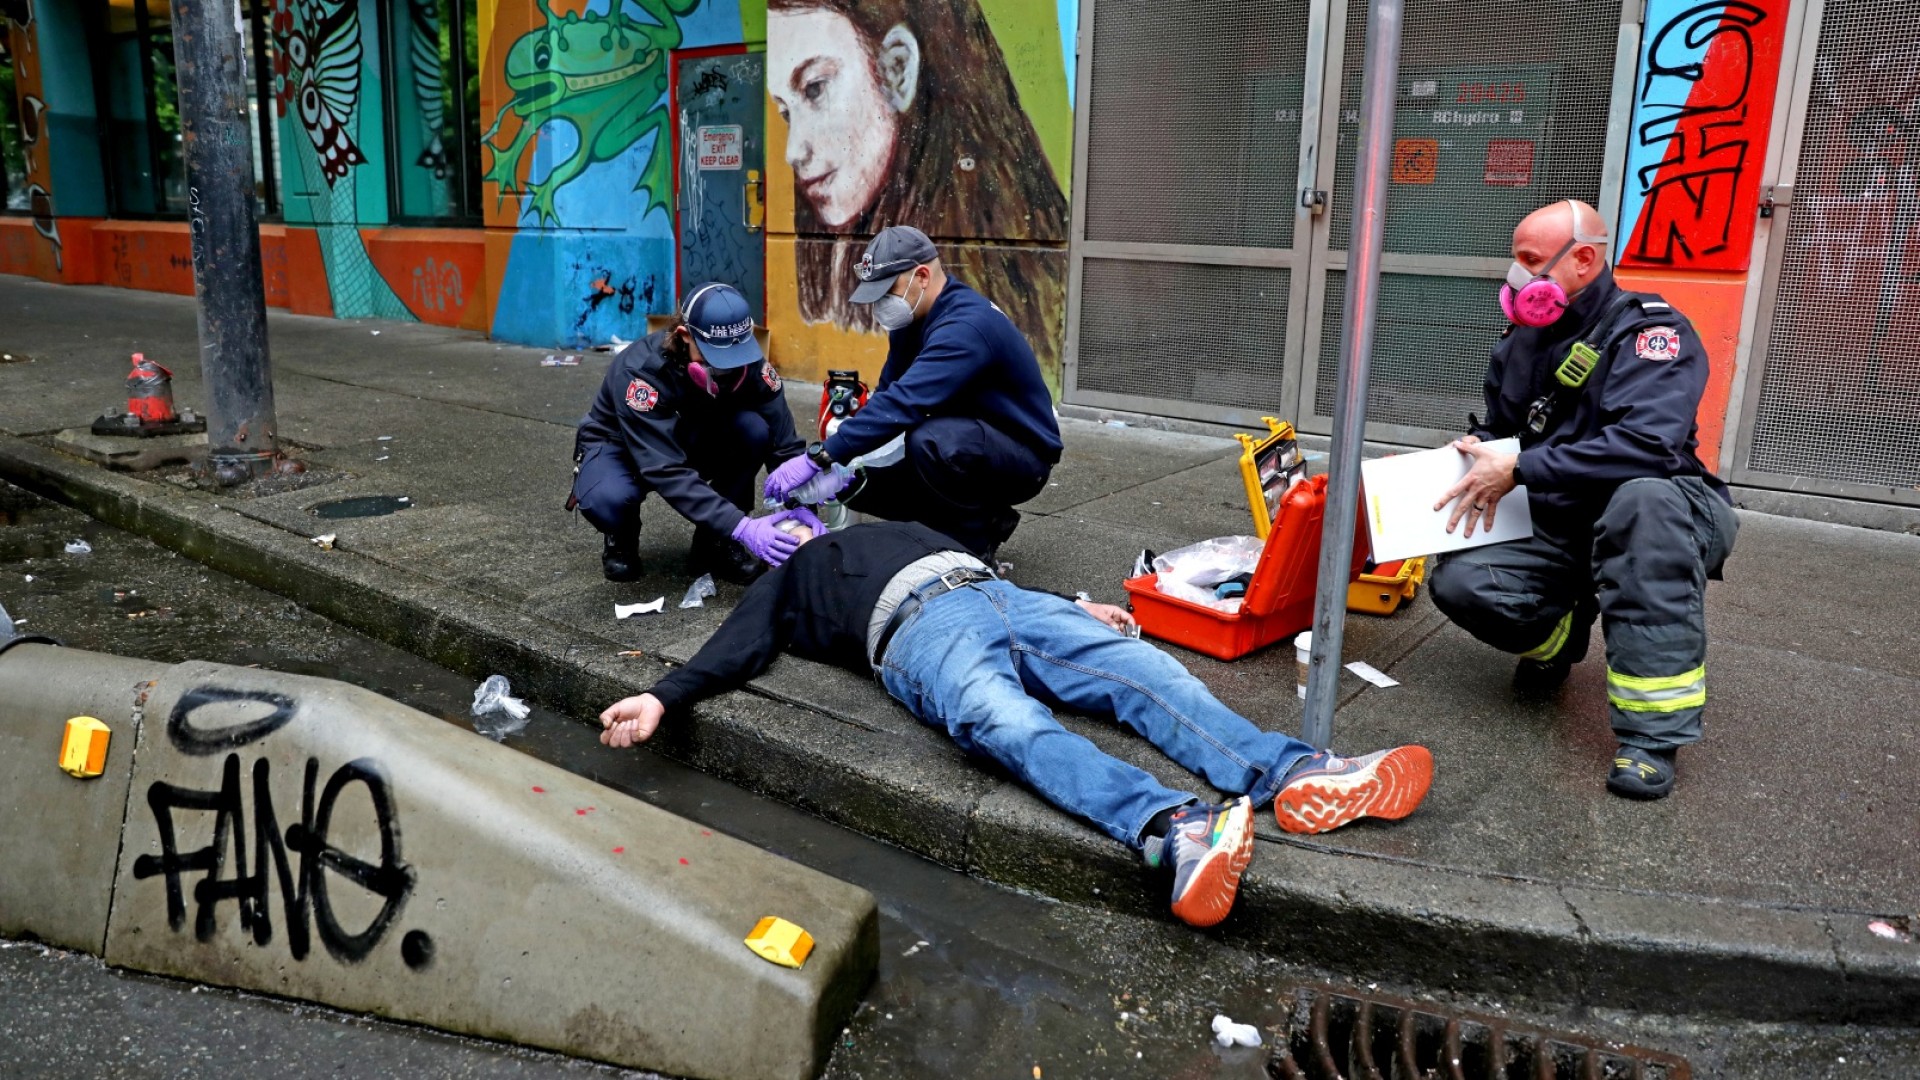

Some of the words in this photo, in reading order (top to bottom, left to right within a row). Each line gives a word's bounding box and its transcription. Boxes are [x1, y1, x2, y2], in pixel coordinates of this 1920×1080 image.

[703, 131, 736, 144] Emergency
[711, 144, 727, 154] EXIT
[700, 155, 717, 166] KEEP
[719, 155, 739, 166] CLEAR
[710, 329, 728, 338] FIRE
